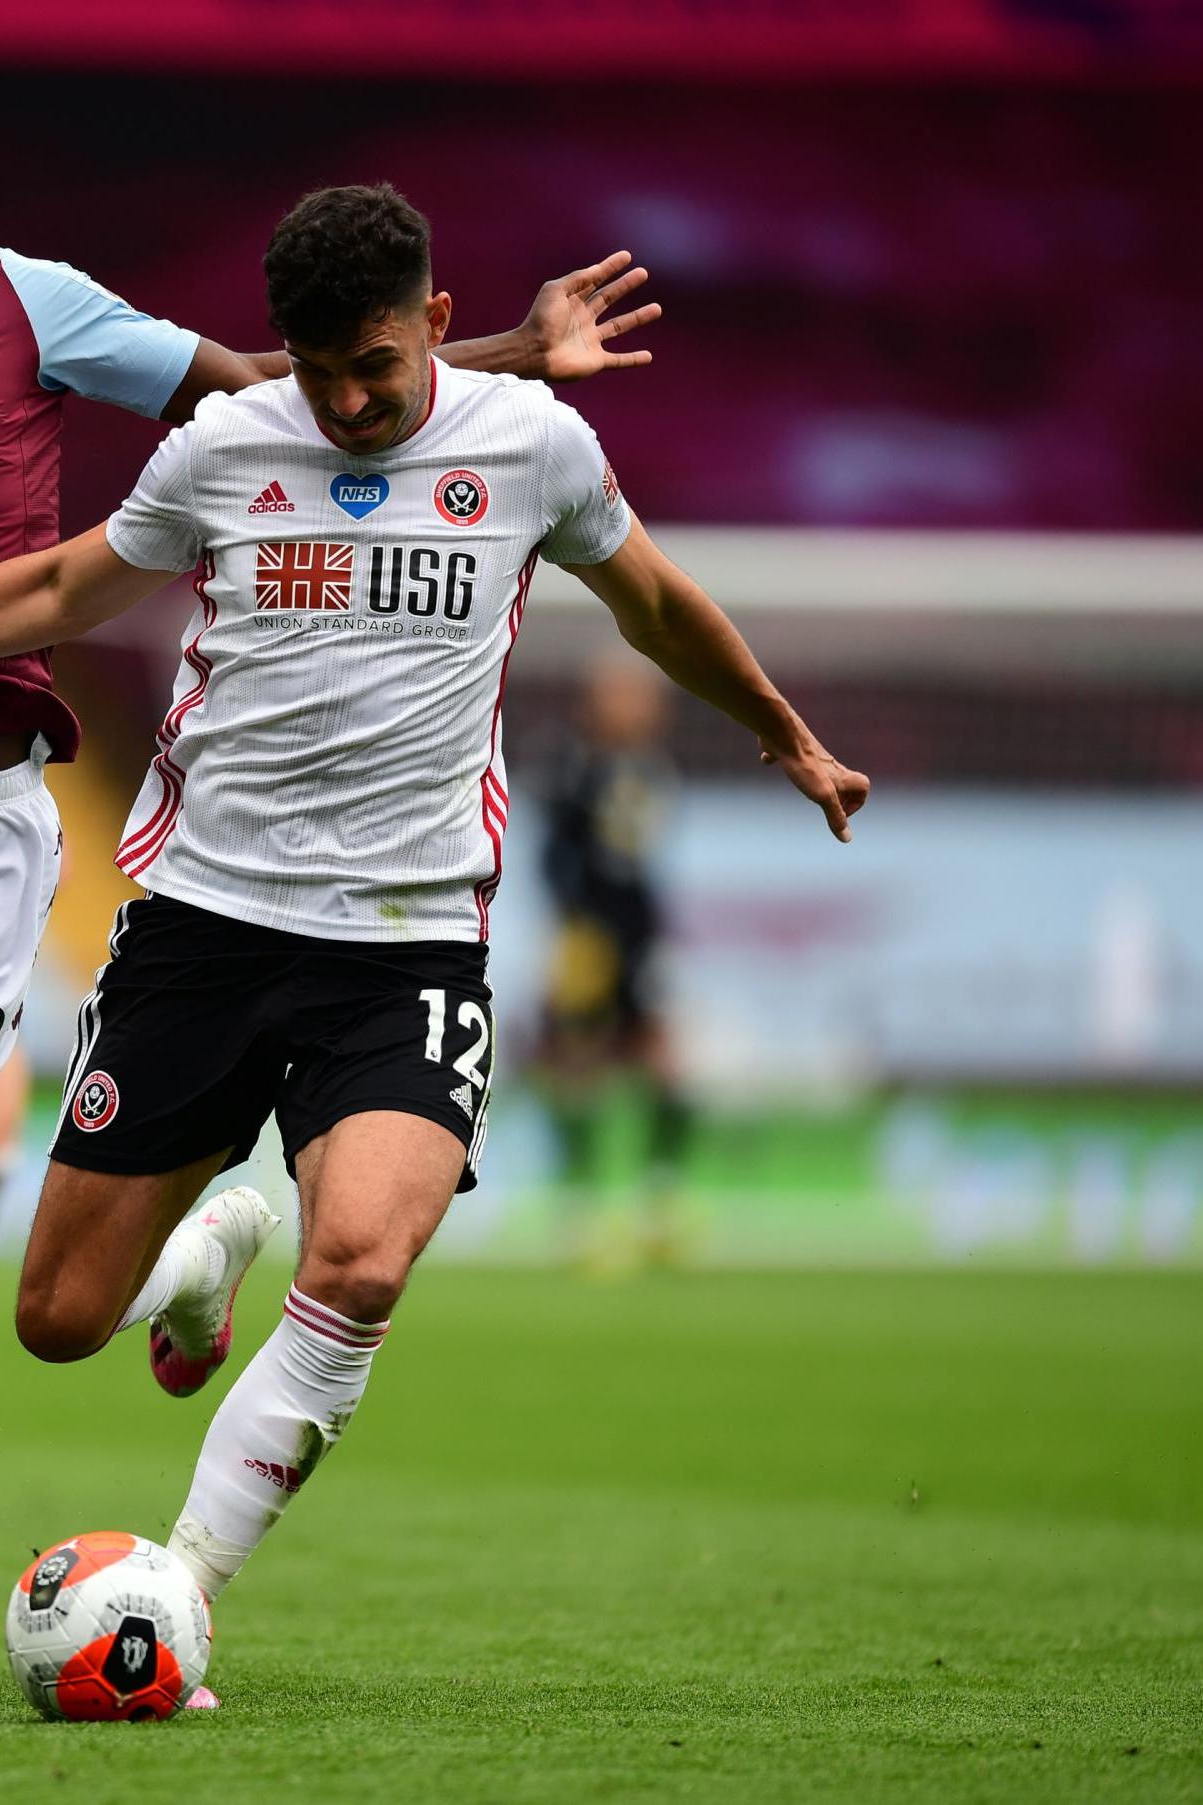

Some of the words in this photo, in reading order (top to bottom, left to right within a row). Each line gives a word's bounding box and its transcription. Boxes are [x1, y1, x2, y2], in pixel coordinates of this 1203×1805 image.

[461, 472, 483, 488] UNITED
[248, 501, 295, 514] adidas
[339, 488, 379, 502] NHS
[368, 546, 477, 622] USG
[254, 616, 303, 629] UNION
[311, 618, 404, 635] STANDARD
[412, 624, 467, 639] GROUP
[418, 988, 489, 1091] 12
[449, 1090, 474, 1121] adidas
[243, 1459, 301, 1493] adida
